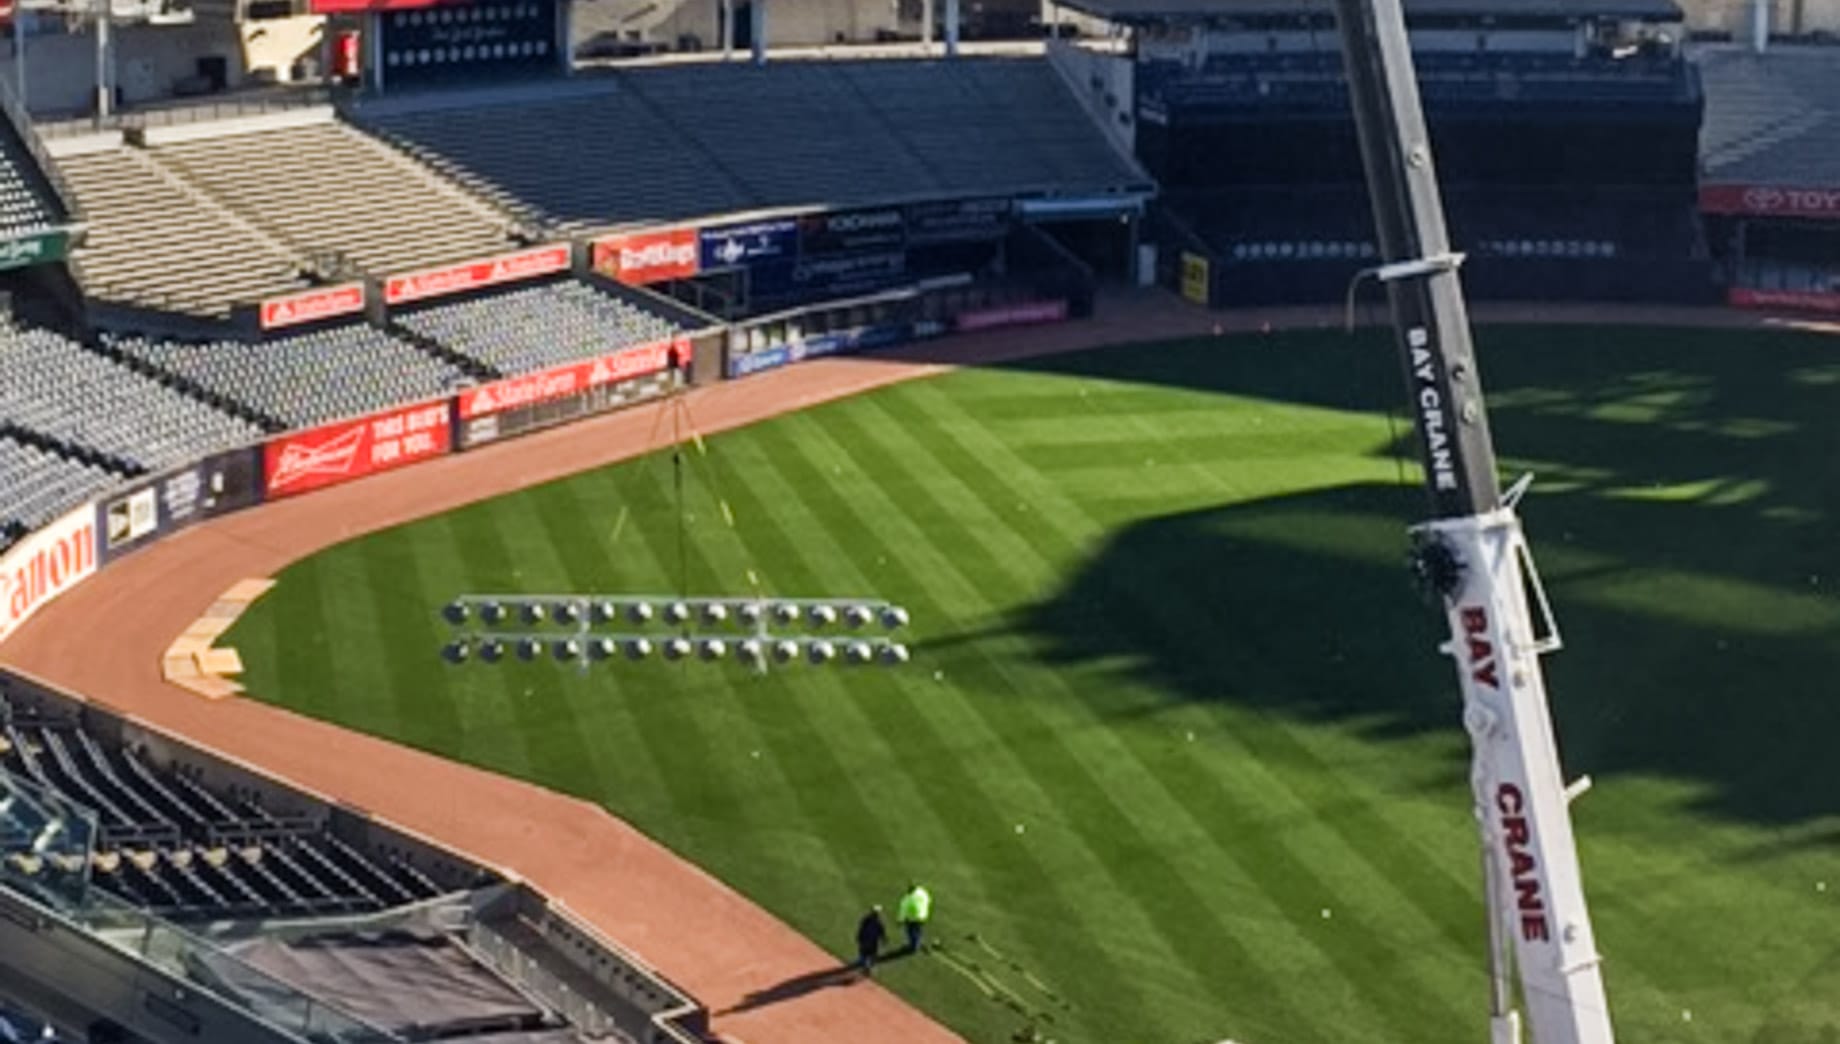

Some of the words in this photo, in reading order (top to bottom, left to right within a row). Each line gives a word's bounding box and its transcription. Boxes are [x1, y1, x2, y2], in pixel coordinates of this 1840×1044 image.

[1407, 328, 1436, 381] BAY
[1420, 386, 1458, 490] CRANE
[0, 523, 93, 634] anon
[1460, 605, 1500, 690] BAY
[1495, 782, 1551, 944] CRANE
